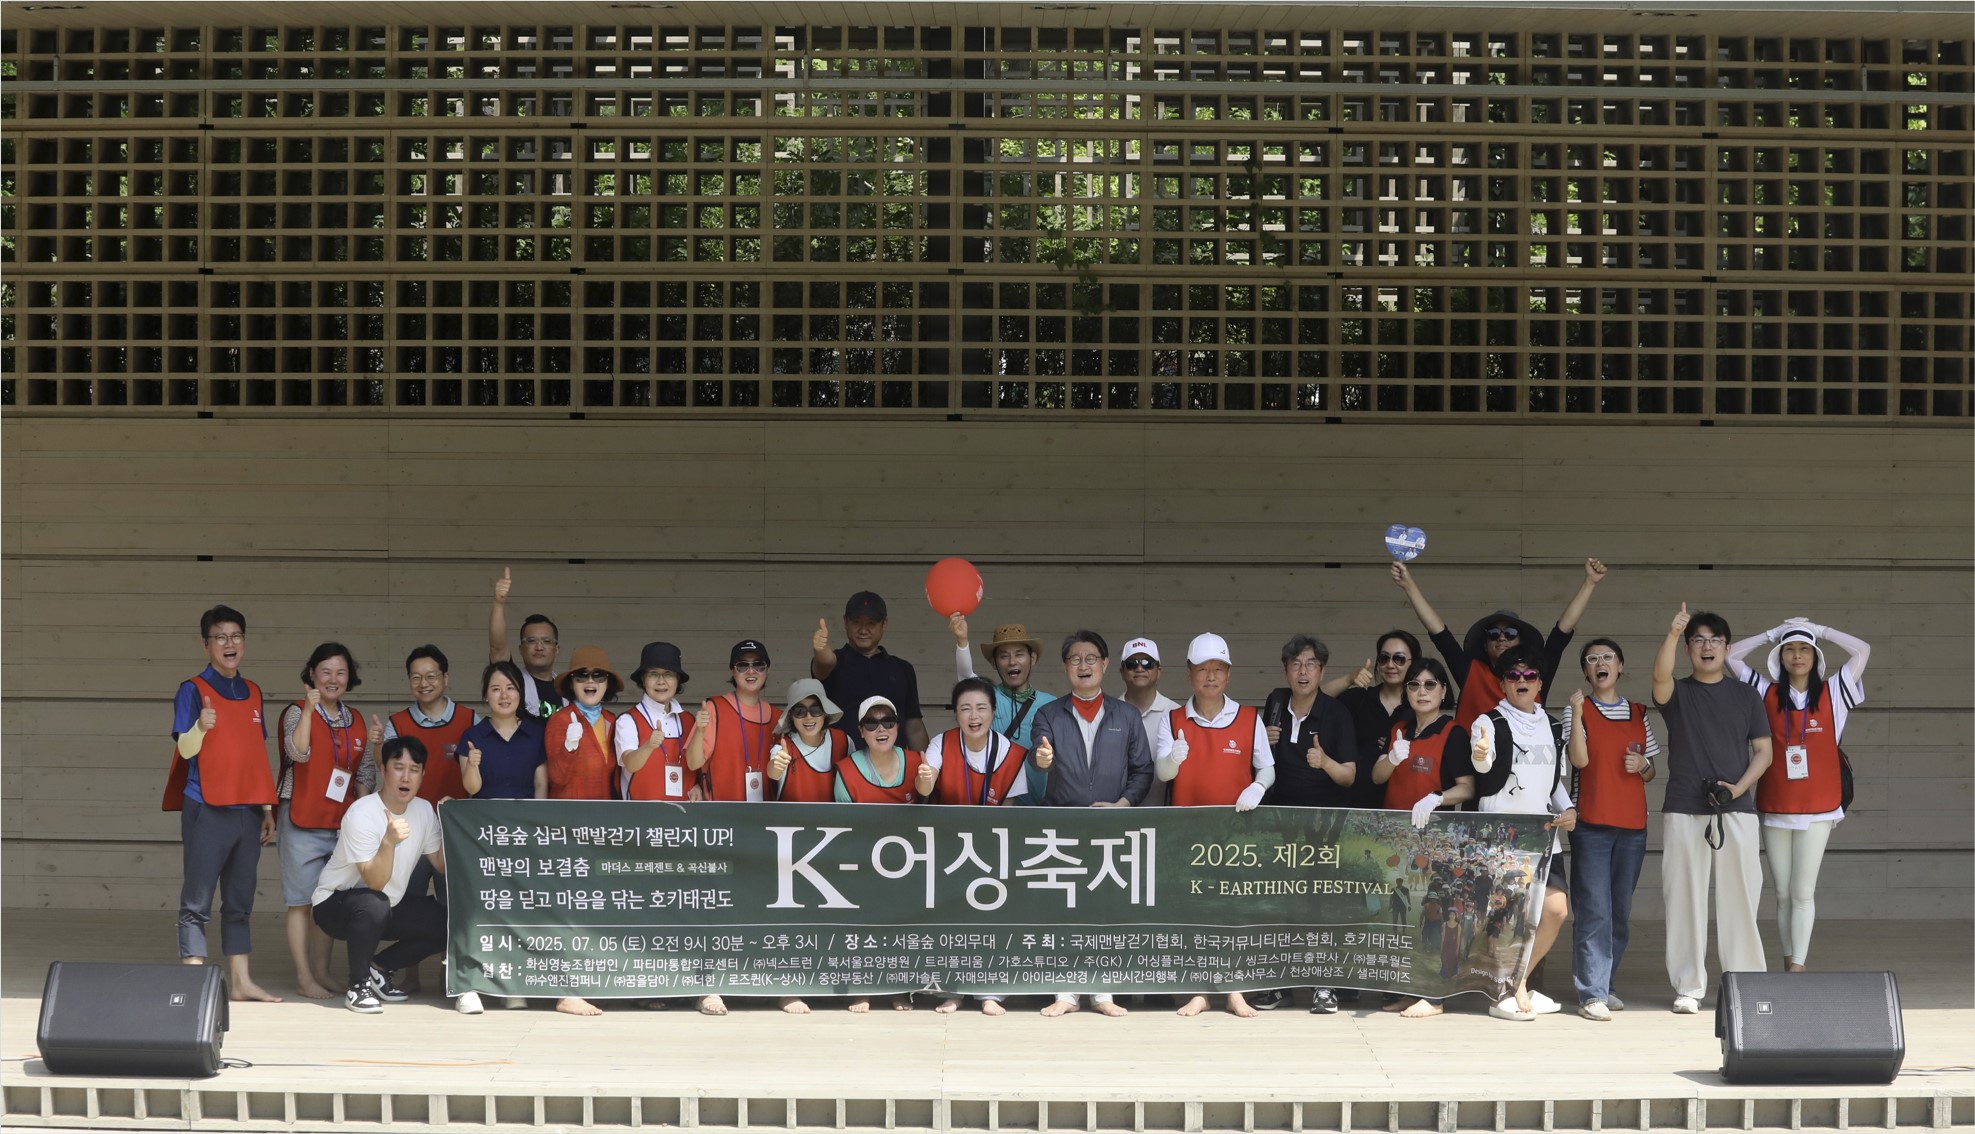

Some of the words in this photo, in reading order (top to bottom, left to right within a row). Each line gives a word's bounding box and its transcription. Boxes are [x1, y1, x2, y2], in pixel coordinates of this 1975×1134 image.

[478, 825, 528, 845] 서울숲
[533, 826, 566, 845] 십리
[572, 827, 640, 846] 맨발걷기
[646, 827, 697, 847] 챌린지
[703, 828, 733, 846] UP!
[1191, 844, 1262, 867] 2025.
[1273, 843, 1340, 868] 제2회
[479, 857, 529, 877] 맨발의
[538, 858, 590, 877] 보결춤
[602, 862, 631, 873] 마더스
[634, 862, 674, 873] 프레젠트
[677, 863, 684, 872] &
[688, 862, 727, 873] 곡신불사
[766, 827, 1155, 910] K-어싱축제
[1191, 880, 1202, 893] K
[1220, 880, 1307, 895] EARTHING
[1313, 879, 1395, 894] FESTIVAL
[480, 889, 514, 910] 땅을
[519, 890, 552, 909] 딛고
[556, 890, 606, 909] 마음을
[611, 890, 644, 909] 닦는
[650, 889, 733, 909] 호키태권도
[527, 936, 566, 951] 2025.
[572, 937, 593, 951] 07.
[600, 937, 617, 951] 05
[622, 936, 646, 953] (토)
[651, 936, 678, 952] 오전
[684, 936, 706, 952] 9시
[712, 936, 744, 951] 30분
[763, 935, 790, 950] 오후
[796, 934, 817, 950] 3시
[892, 934, 934, 948] 서울숲
[940, 934, 995, 948] 야외무대
[1070, 934, 1187, 949] 국제맨발걷기협회,
[1194, 932, 1336, 950] 한국커뮤니티댄스협회,
[1343, 933, 1413, 949] 호키태권도
[526, 958, 617, 972] 화심영농조합법인
[633, 958, 737, 972] 파티마통합의료센터
[828, 956, 909, 969] 북서울요양병원
[925, 956, 983, 968] 트리폴리움
[999, 956, 1069, 968] 가호스튜디오
[1084, 955, 1122, 968] 주(GK)
[1138, 955, 1230, 968] 어싱플러스컴퍼니
[1246, 952, 1340, 968] 씽크스마트출판사
[728, 973, 805, 986] 로즈퀸(K-상사)
[819, 972, 873, 985] 중앙부동산
[955, 972, 1008, 984] 자매의부엌
[1023, 971, 1089, 985] 아이리스안경
[1101, 971, 1177, 983] 십만시간의행복
[1290, 966, 1343, 977] 천상애상조
[1357, 966, 1411, 983] 샐러데이즈
